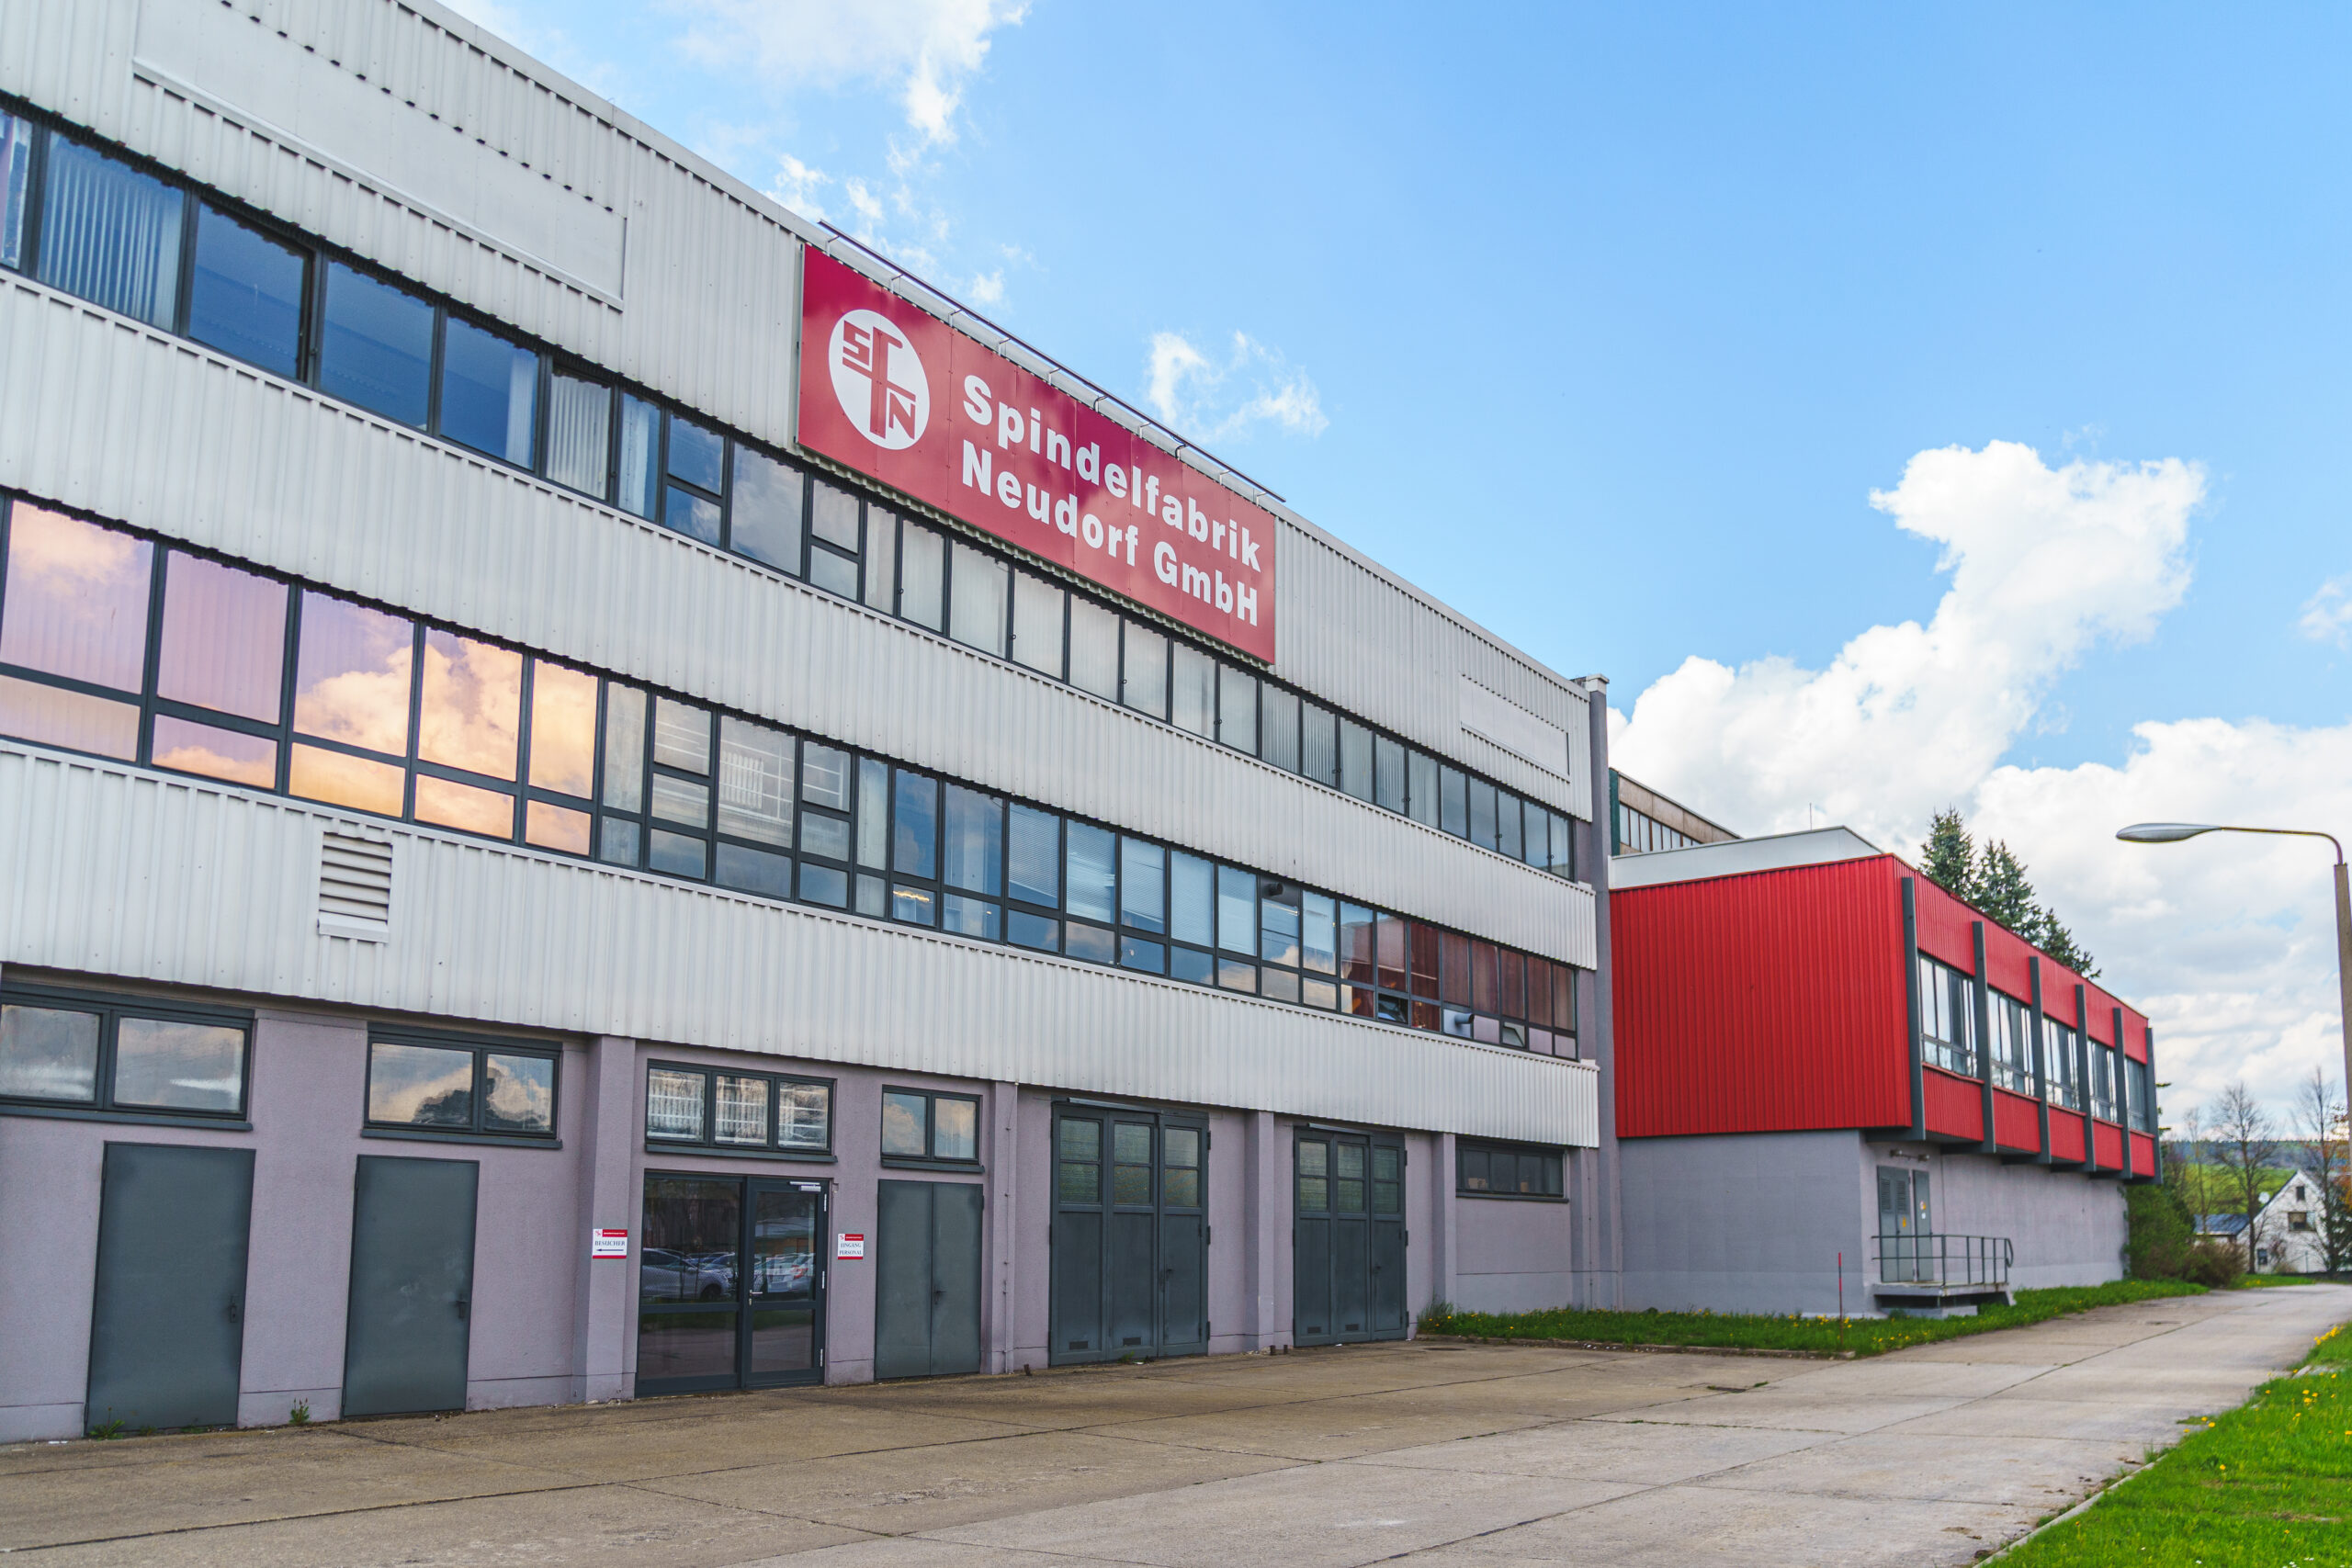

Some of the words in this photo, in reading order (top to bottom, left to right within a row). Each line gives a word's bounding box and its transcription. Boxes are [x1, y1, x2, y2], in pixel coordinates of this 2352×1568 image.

[962, 374, 1262, 574] Spindelfabrik
[962, 438, 1140, 567] Neudorf
[1153, 540, 1258, 627] GmbH
